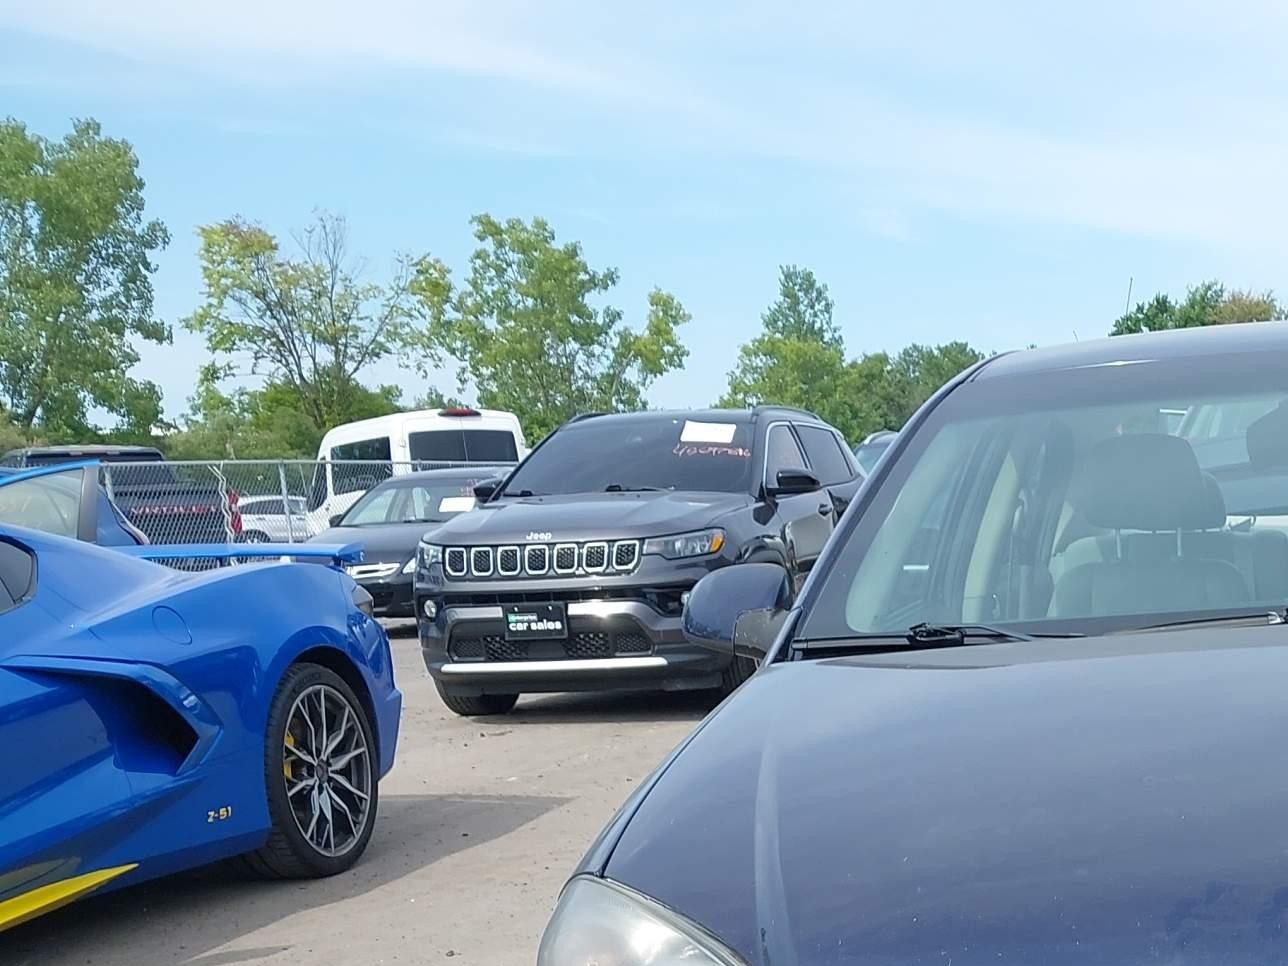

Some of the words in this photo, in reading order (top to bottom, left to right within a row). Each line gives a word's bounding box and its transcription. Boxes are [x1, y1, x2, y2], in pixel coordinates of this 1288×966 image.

[525, 531, 553, 541] Jeep
[508, 621, 529, 632] car
[530, 618, 563, 631] sales
